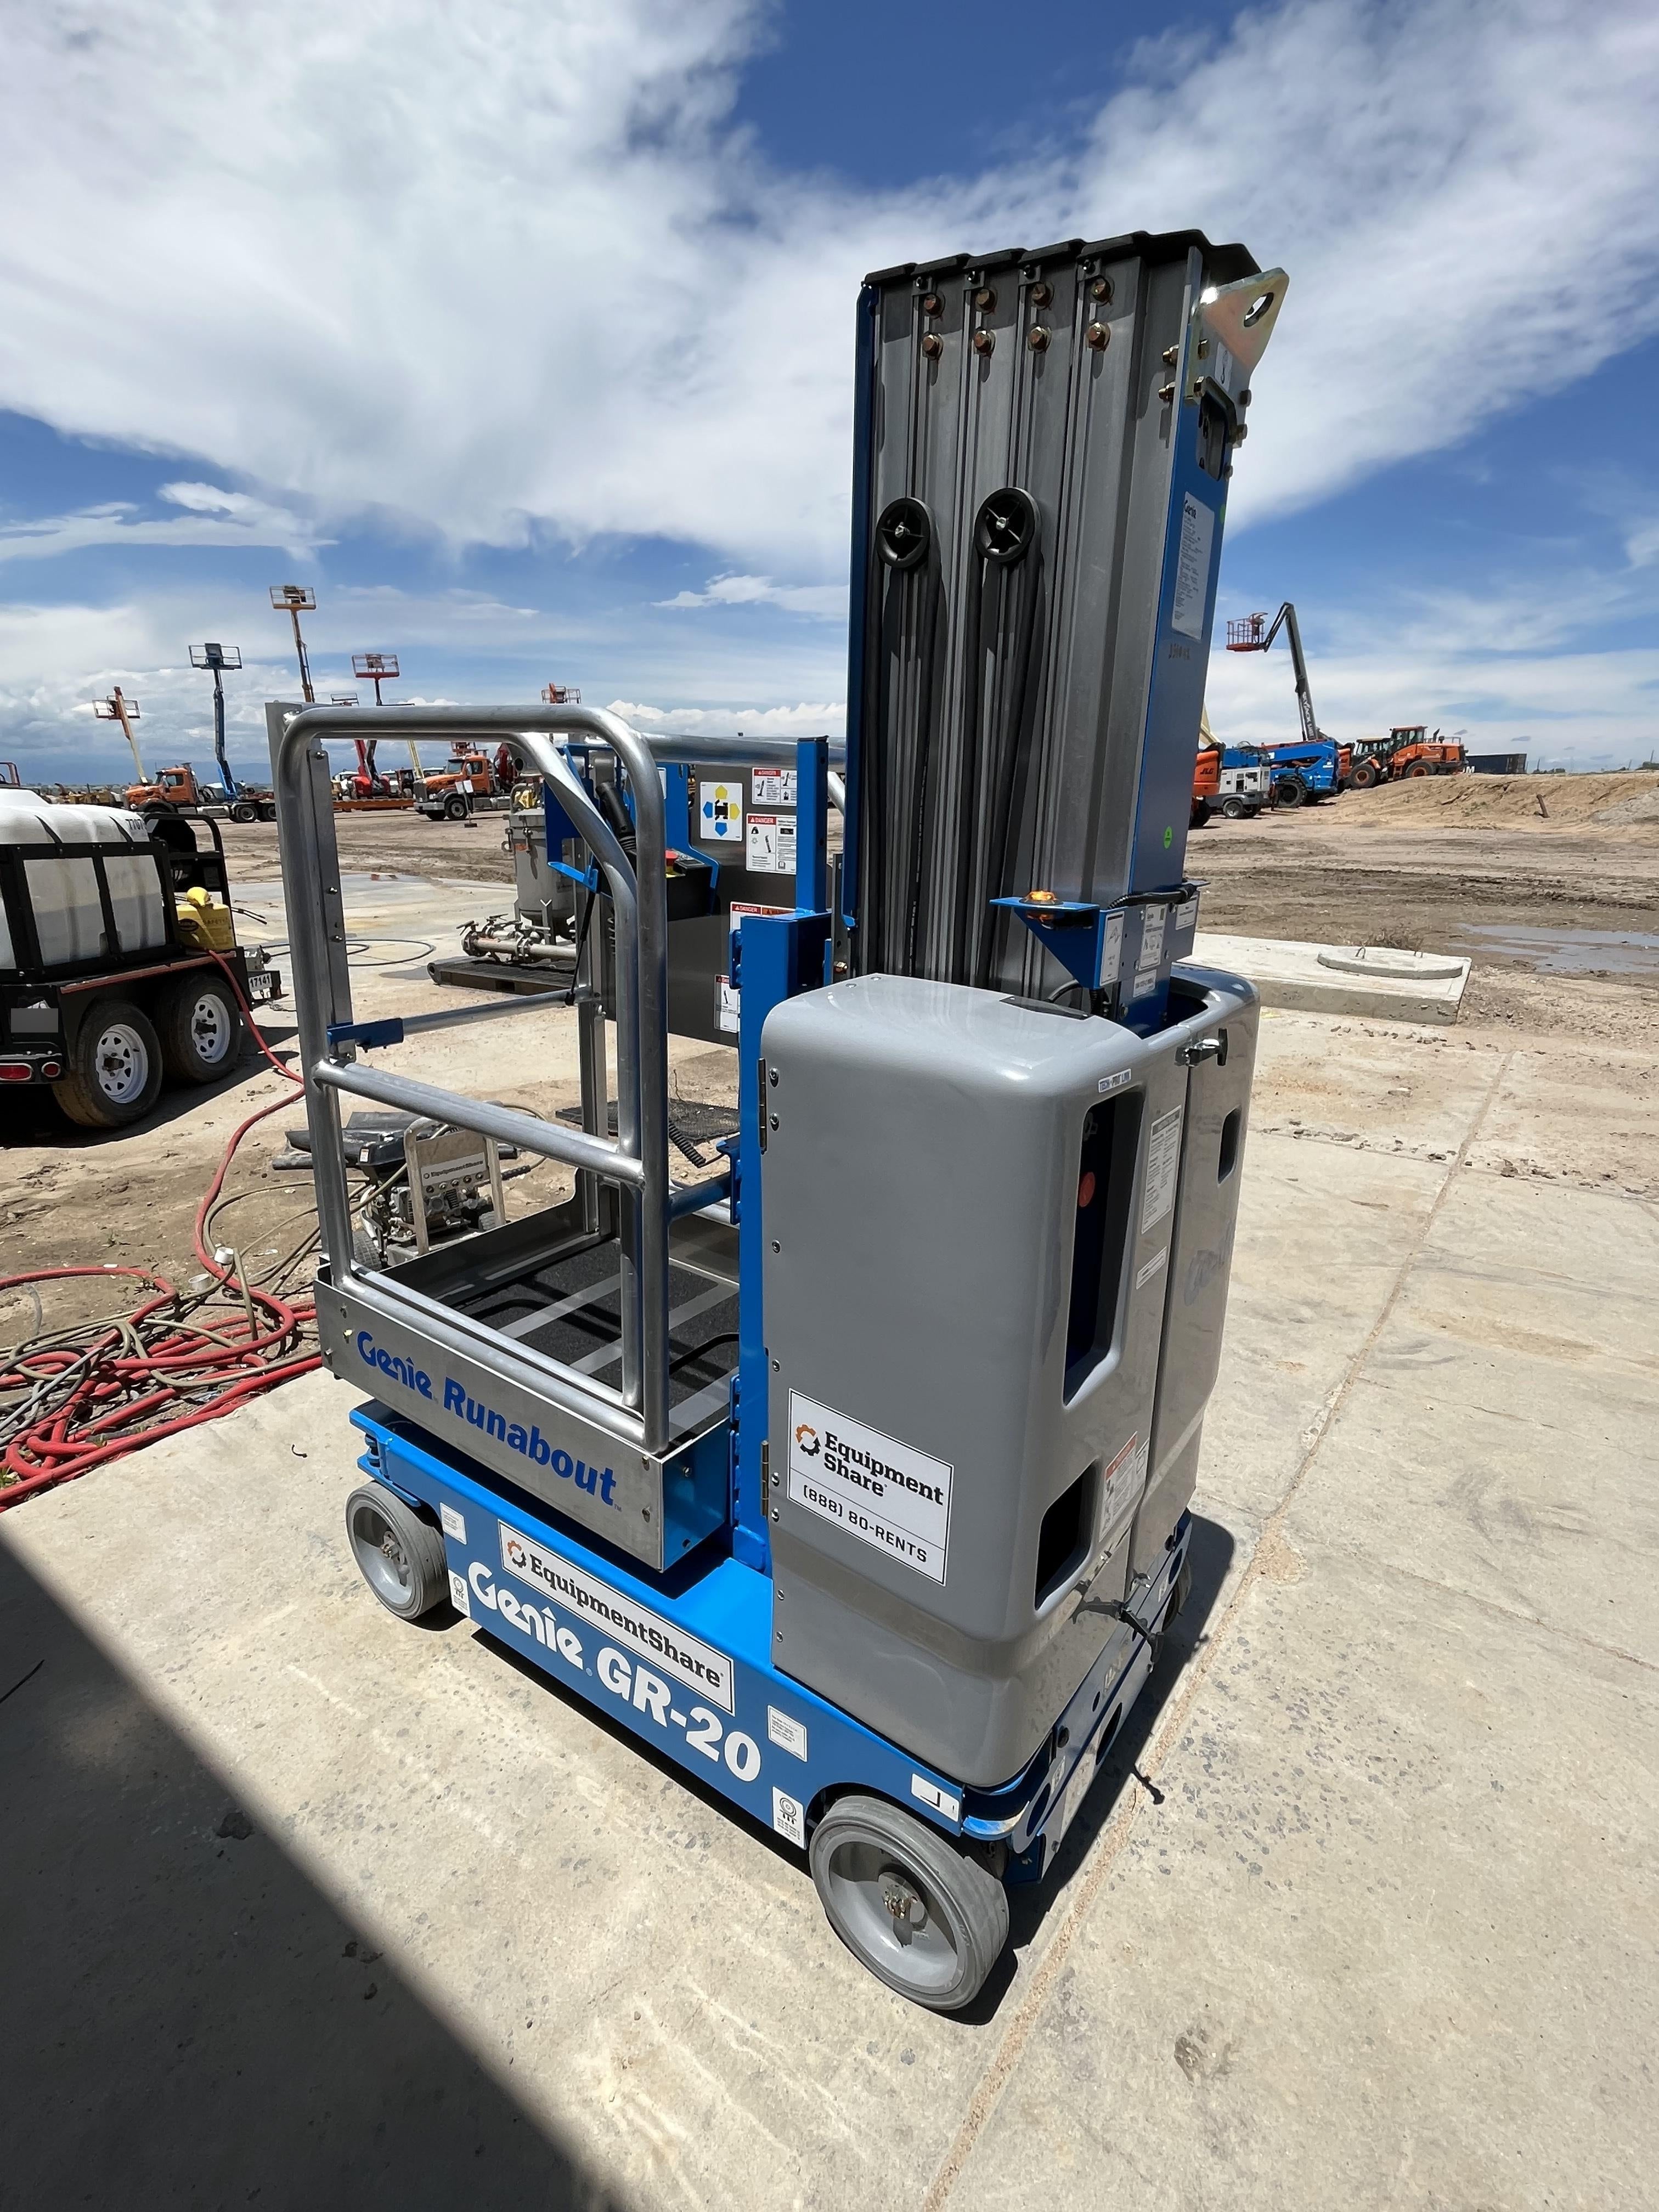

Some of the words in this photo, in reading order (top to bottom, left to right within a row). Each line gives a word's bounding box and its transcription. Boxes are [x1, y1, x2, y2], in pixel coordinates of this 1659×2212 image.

[250, 974, 270, 988] 17141
[357, 1331, 433, 1400] Genie
[443, 1377, 617, 1506] Runabout
[824, 1452, 884, 1497] Share
[825, 1431, 944, 1506] Equipment
[803, 1485, 843, 1517] (888)
[848, 1510, 927, 1563] 80-RENTS
[529, 1554, 721, 1689] EquipmentShare
[468, 1561, 584, 1670] Genie
[596, 1647, 762, 1782] GR-20
